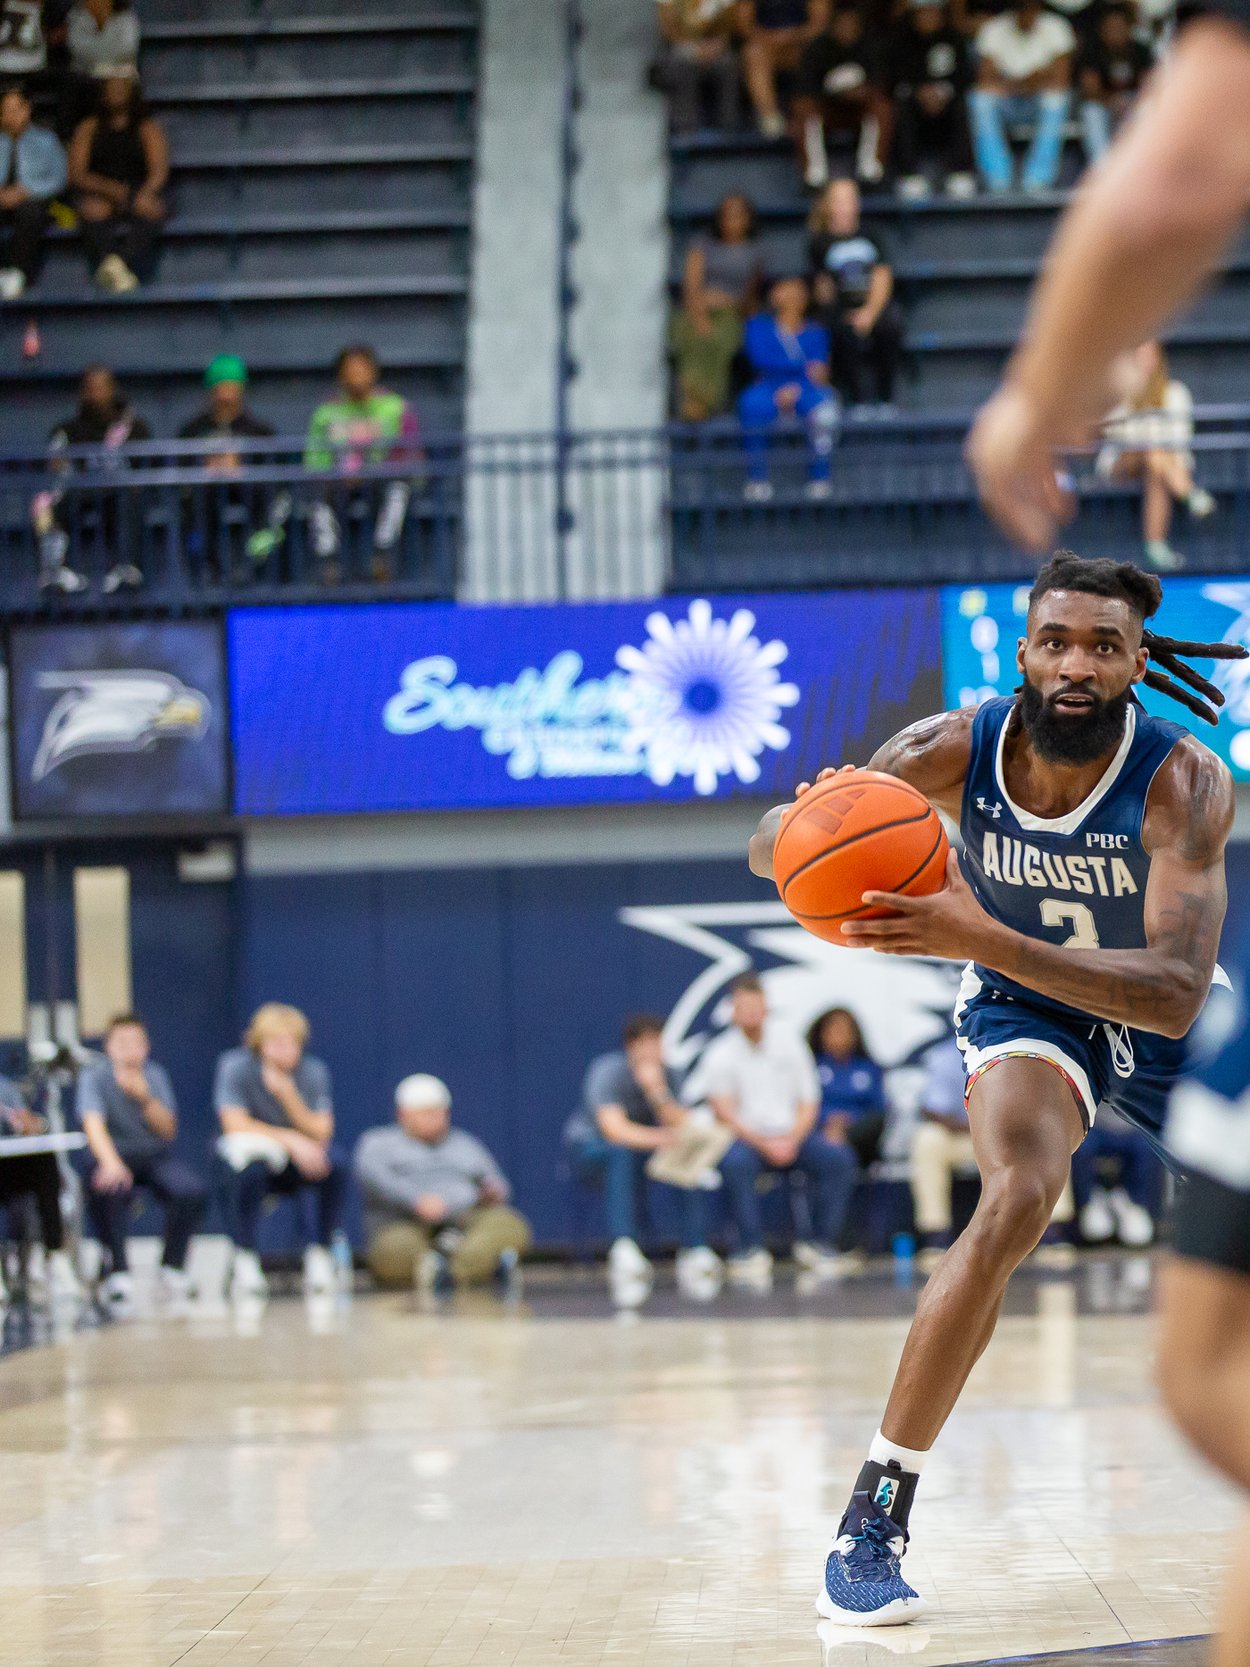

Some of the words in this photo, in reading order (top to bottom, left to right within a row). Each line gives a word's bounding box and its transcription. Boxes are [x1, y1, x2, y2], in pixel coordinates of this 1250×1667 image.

[383, 650, 655, 737] Southe
[982, 831, 1139, 897] AUGUSTA
[1085, 832, 1129, 850] PBC
